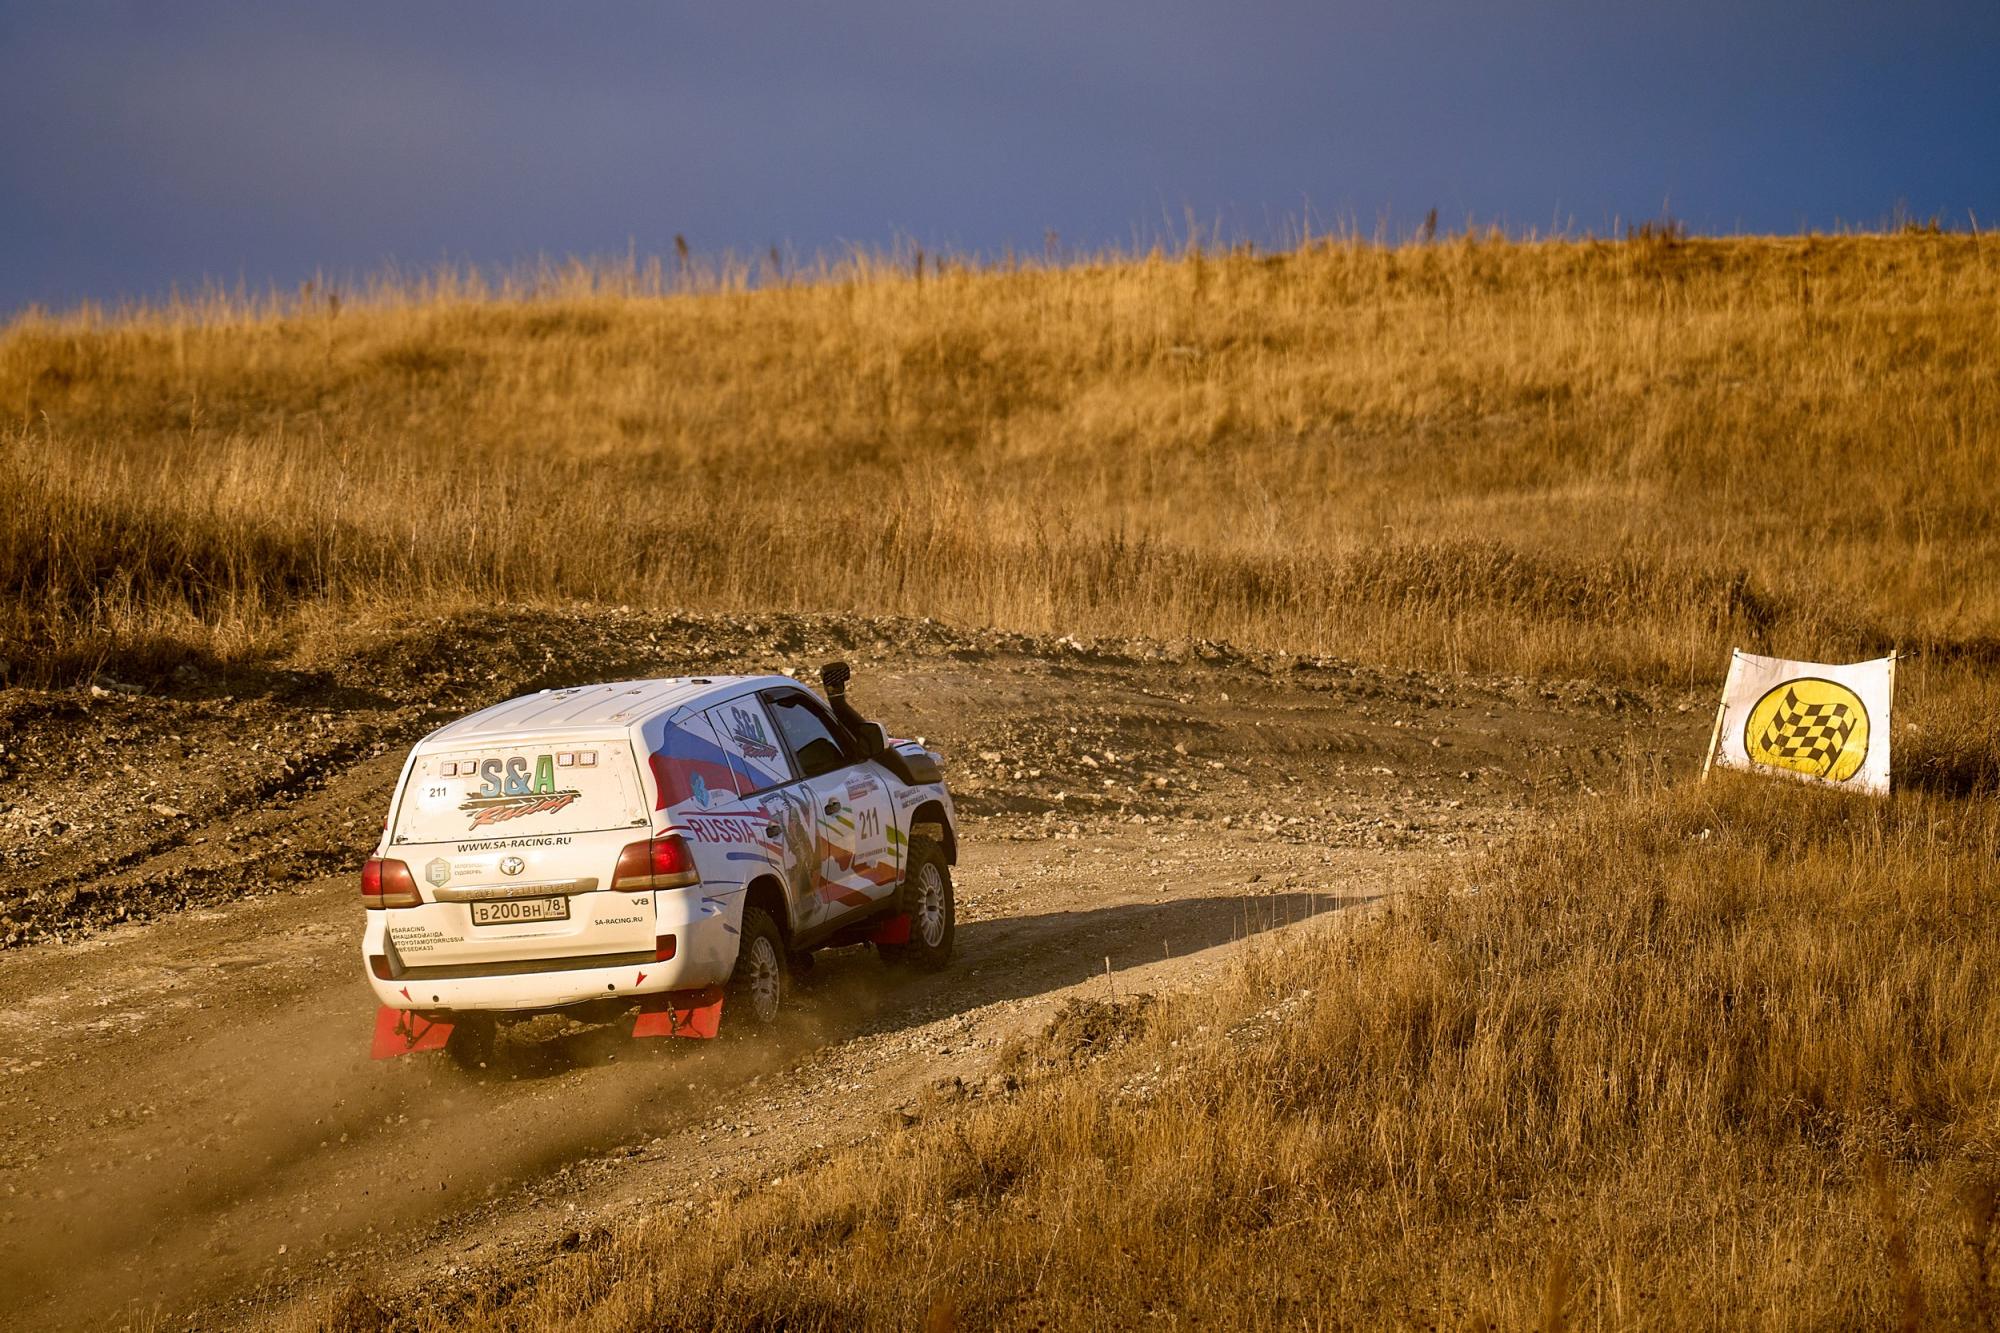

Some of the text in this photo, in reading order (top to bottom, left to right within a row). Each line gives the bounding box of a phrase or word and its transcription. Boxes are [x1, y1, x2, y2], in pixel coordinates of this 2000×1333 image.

[731, 706, 769, 746] S&A
[479, 754, 556, 798] S&A
[429, 787, 447, 798] 211
[468, 794, 575, 831] Racing
[687, 818, 759, 844] RUSSIA
[859, 807, 879, 840] 211
[457, 836, 572, 853] WWW.SA-RACING.RU
[631, 897, 649, 905] V8
[391, 926, 426, 934] #SARACING
[594, 916, 643, 926] SA-RACING.RU
